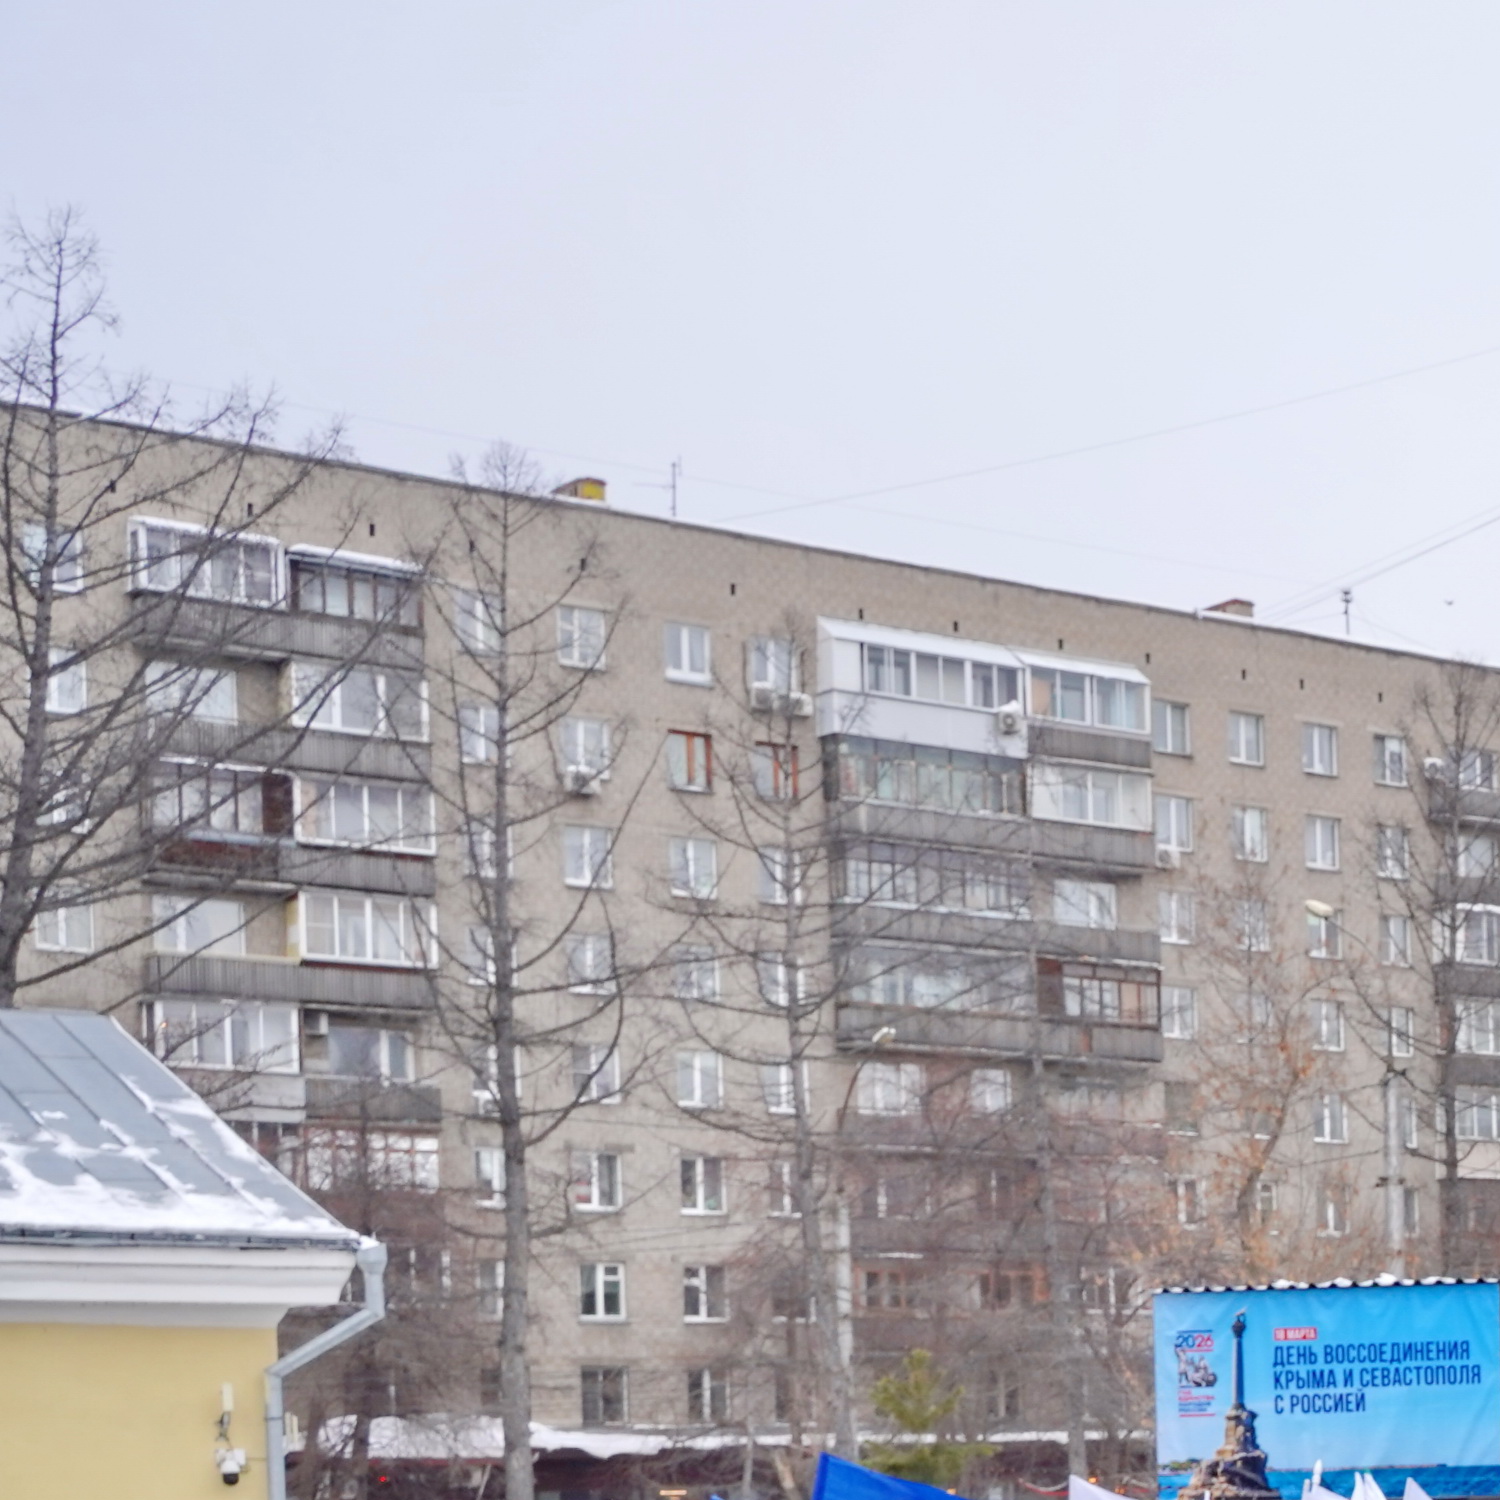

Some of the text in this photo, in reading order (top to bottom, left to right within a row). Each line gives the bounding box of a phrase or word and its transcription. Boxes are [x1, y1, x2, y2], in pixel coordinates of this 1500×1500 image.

[1176, 1334, 1214, 1348] 2026
[1272, 1340, 1470, 1368] ДЕНЬ ВОССОЕДИНЕНИЯ
[1273, 1363, 1481, 1390] КРЫМА И СЕВАСТОПОЛЯ
[1274, 1389, 1366, 1414] С РОССИЕЙ
